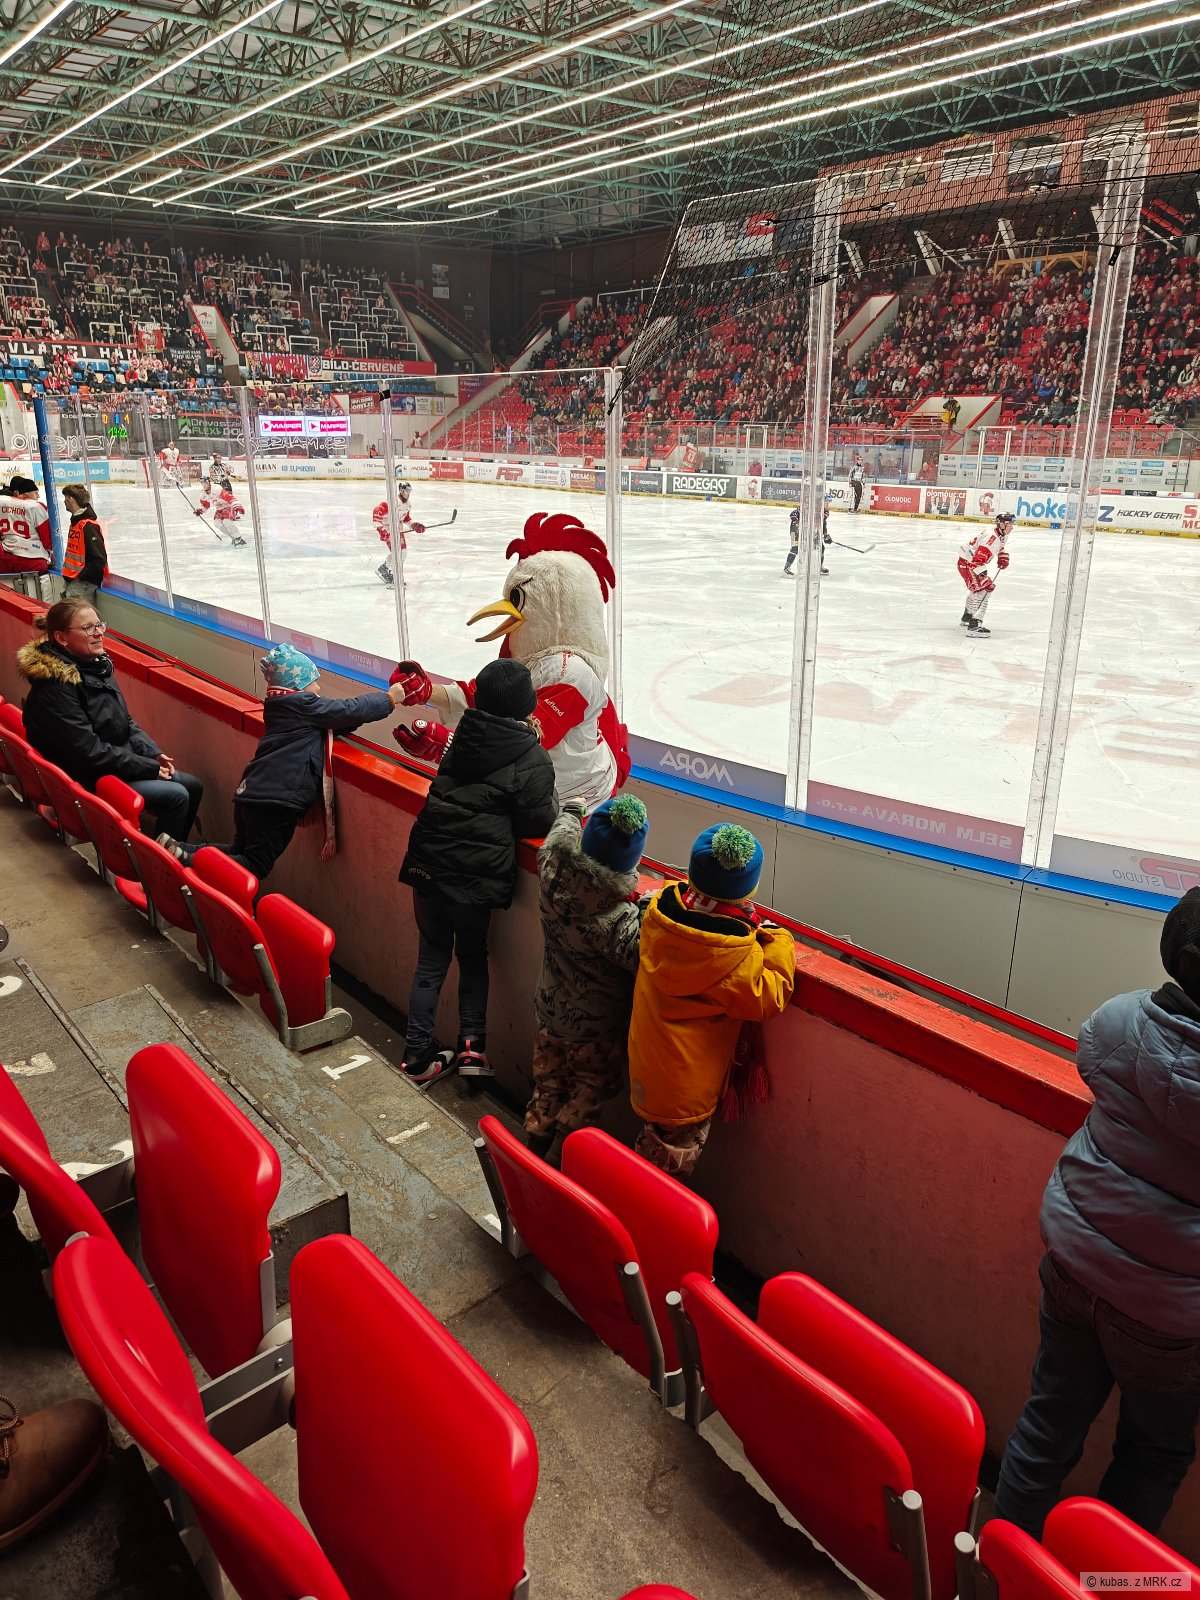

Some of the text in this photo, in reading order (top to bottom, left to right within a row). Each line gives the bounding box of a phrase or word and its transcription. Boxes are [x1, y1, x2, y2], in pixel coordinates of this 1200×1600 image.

[322, 358, 405, 373] BÍLO-ČERVENÉ
[672, 476, 730, 496] RADEGAST
[1016, 496, 1078, 520] hoke
[1117, 509, 1153, 518] HOCKEY
